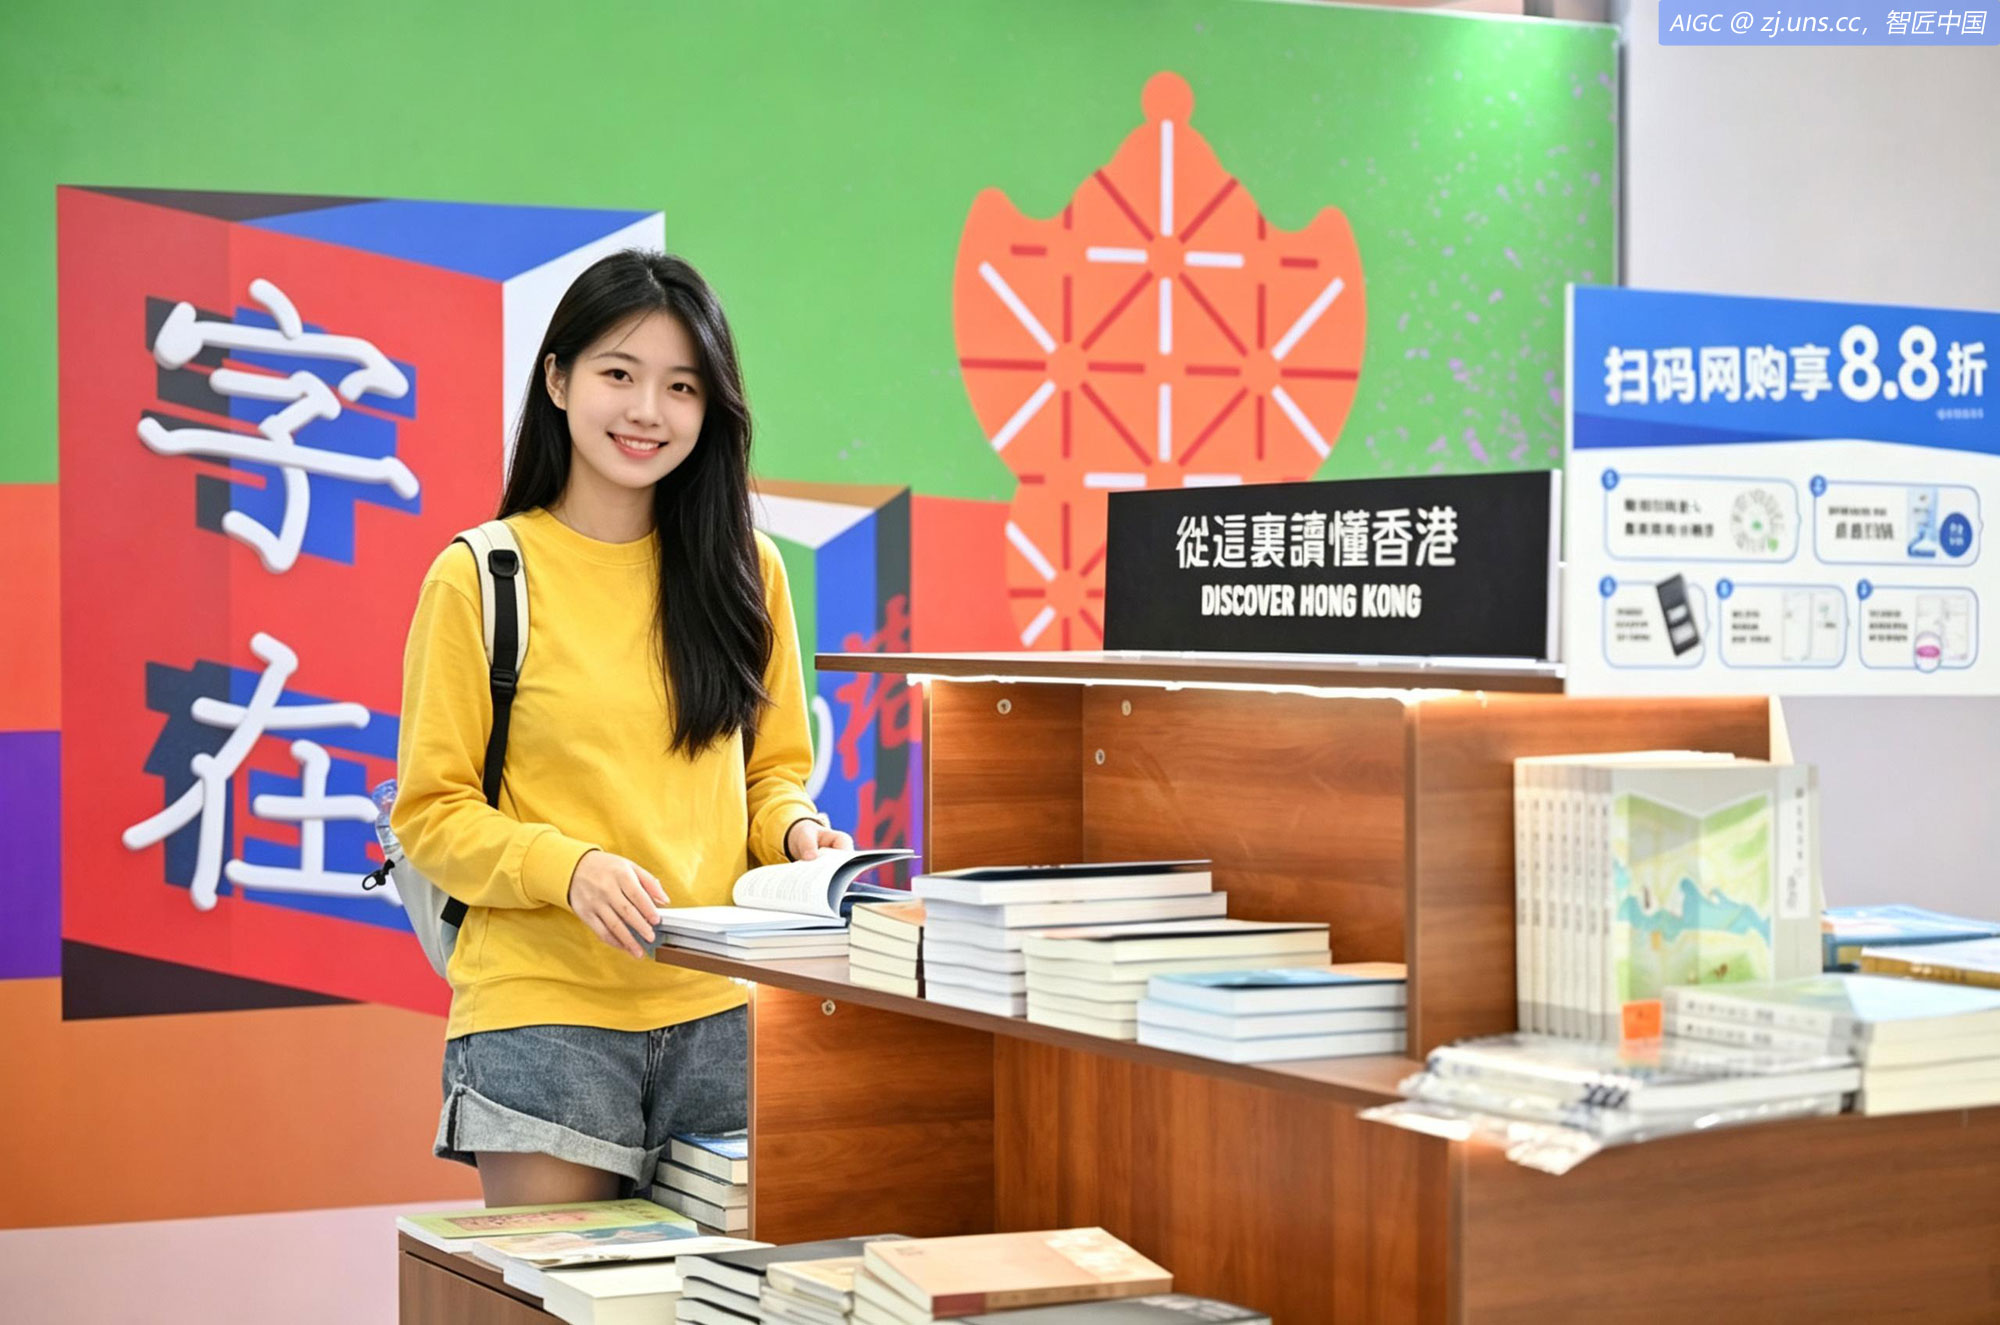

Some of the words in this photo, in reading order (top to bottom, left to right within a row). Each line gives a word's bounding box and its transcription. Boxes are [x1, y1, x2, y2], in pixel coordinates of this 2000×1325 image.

[1604, 324, 1988, 405] 扫码网购享8.8折
[1175, 505, 1459, 569] 從這裏讀懂香港
[1201, 584, 1296, 617] DISCOVER
[1299, 583, 1358, 618] HONG
[1361, 583, 1423, 618] KONG
